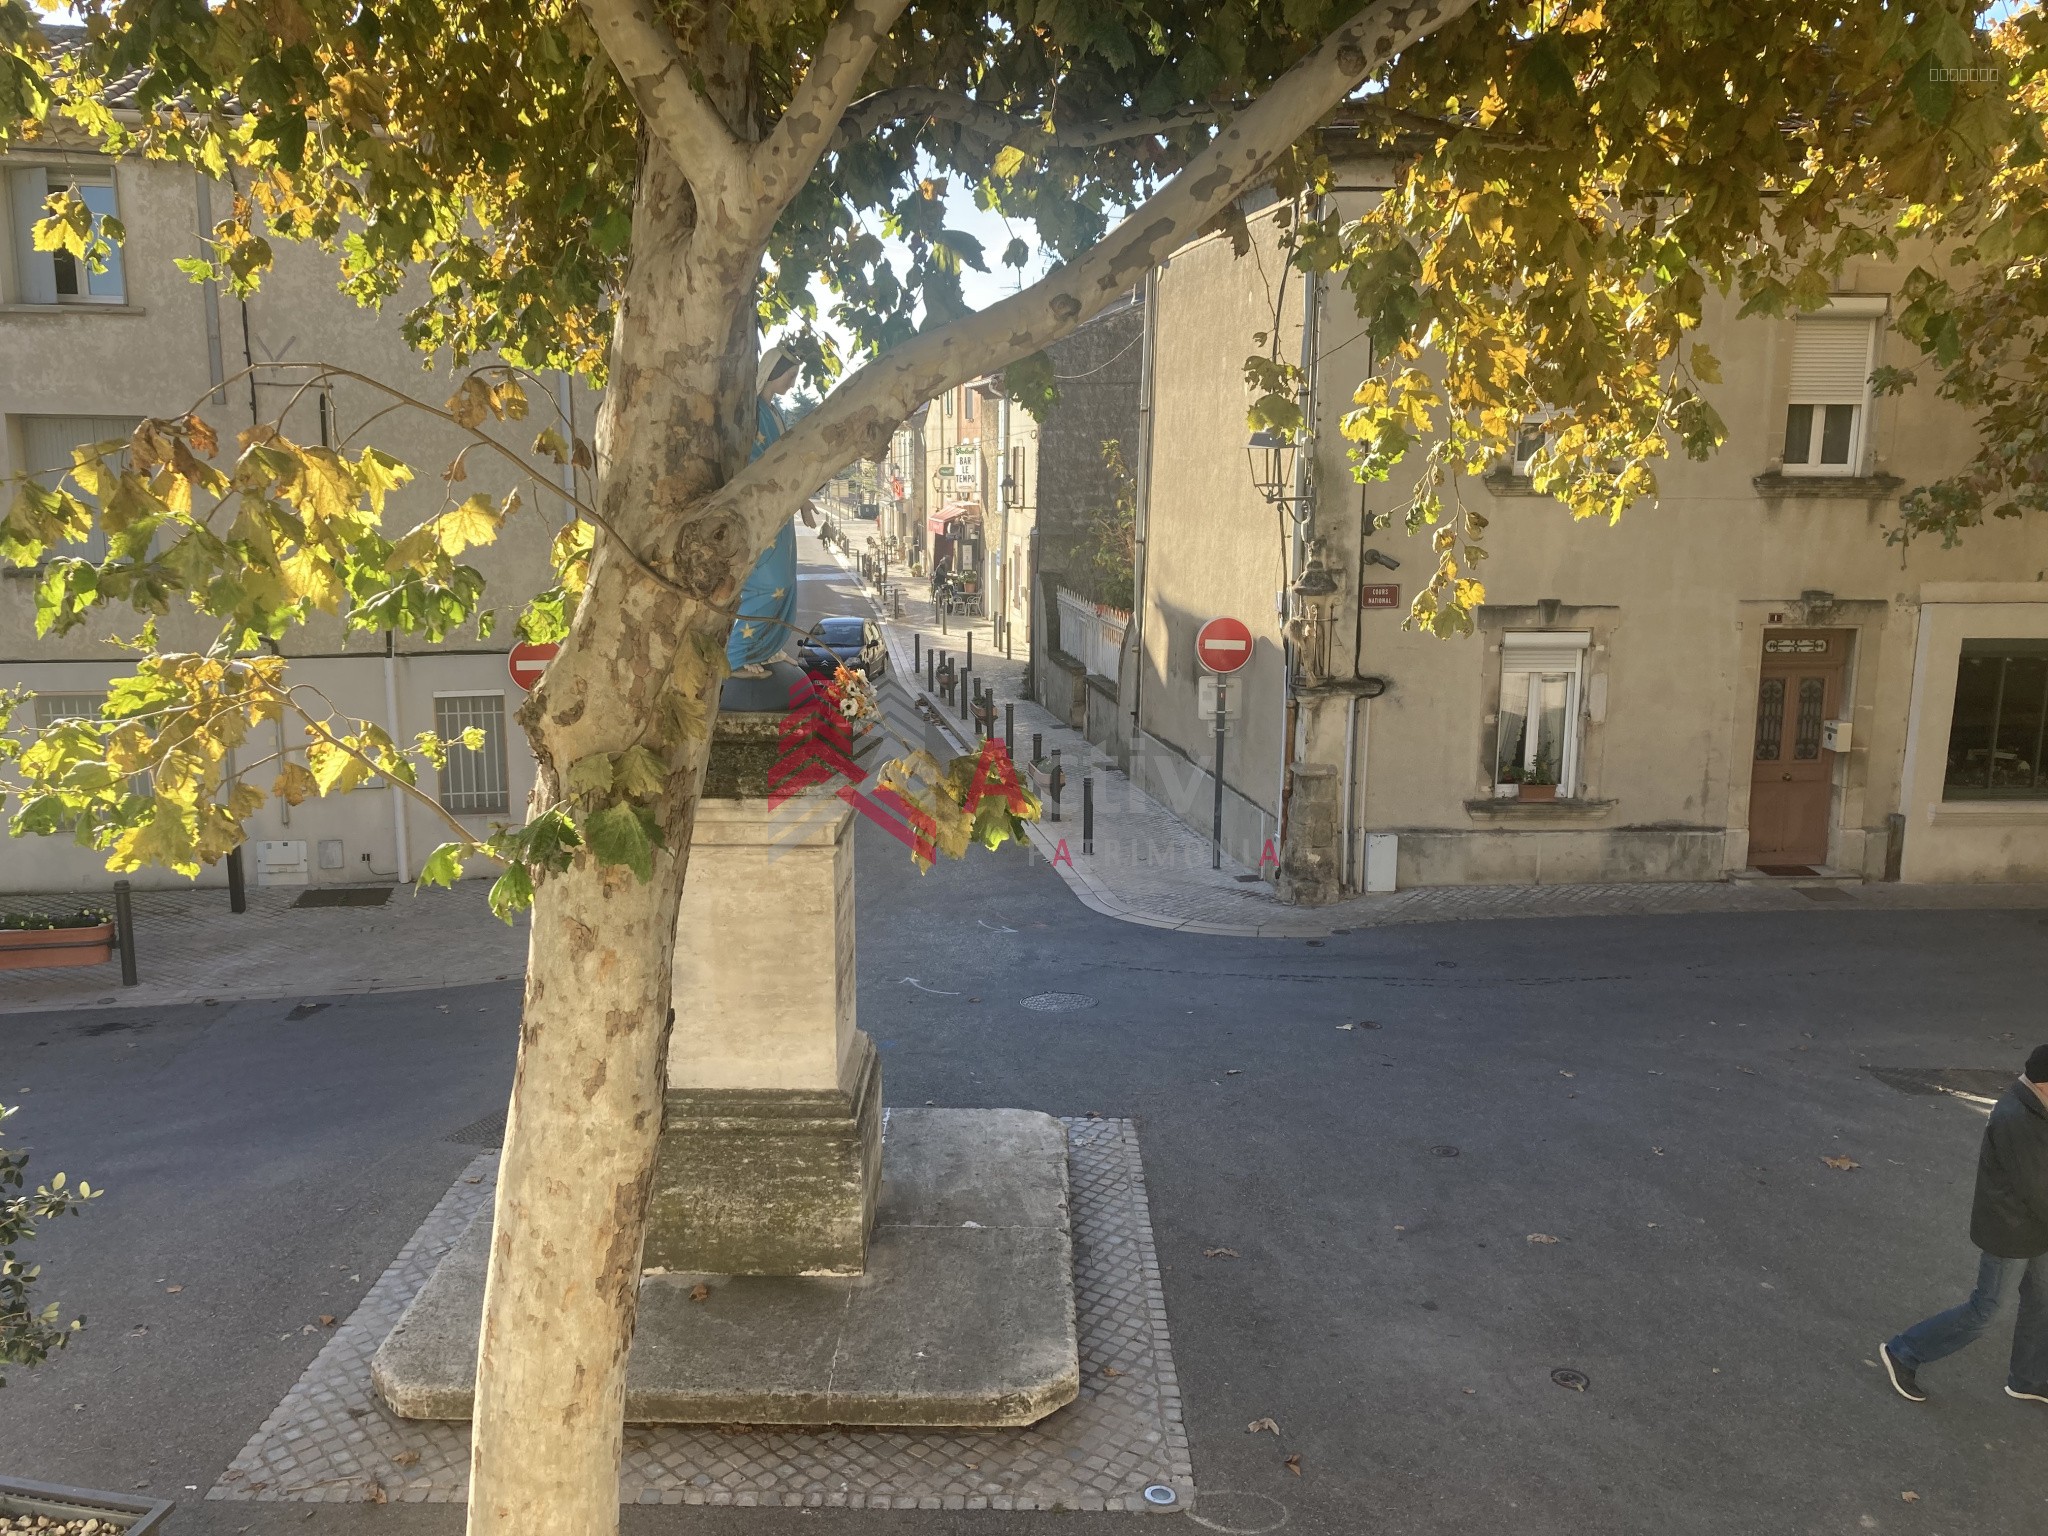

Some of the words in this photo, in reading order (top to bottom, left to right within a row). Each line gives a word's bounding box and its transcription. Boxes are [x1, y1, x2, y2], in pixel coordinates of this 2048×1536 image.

[960, 456, 972, 465] BAR
[962, 466, 969, 474] LE
[956, 475, 975, 483] TEMPO
